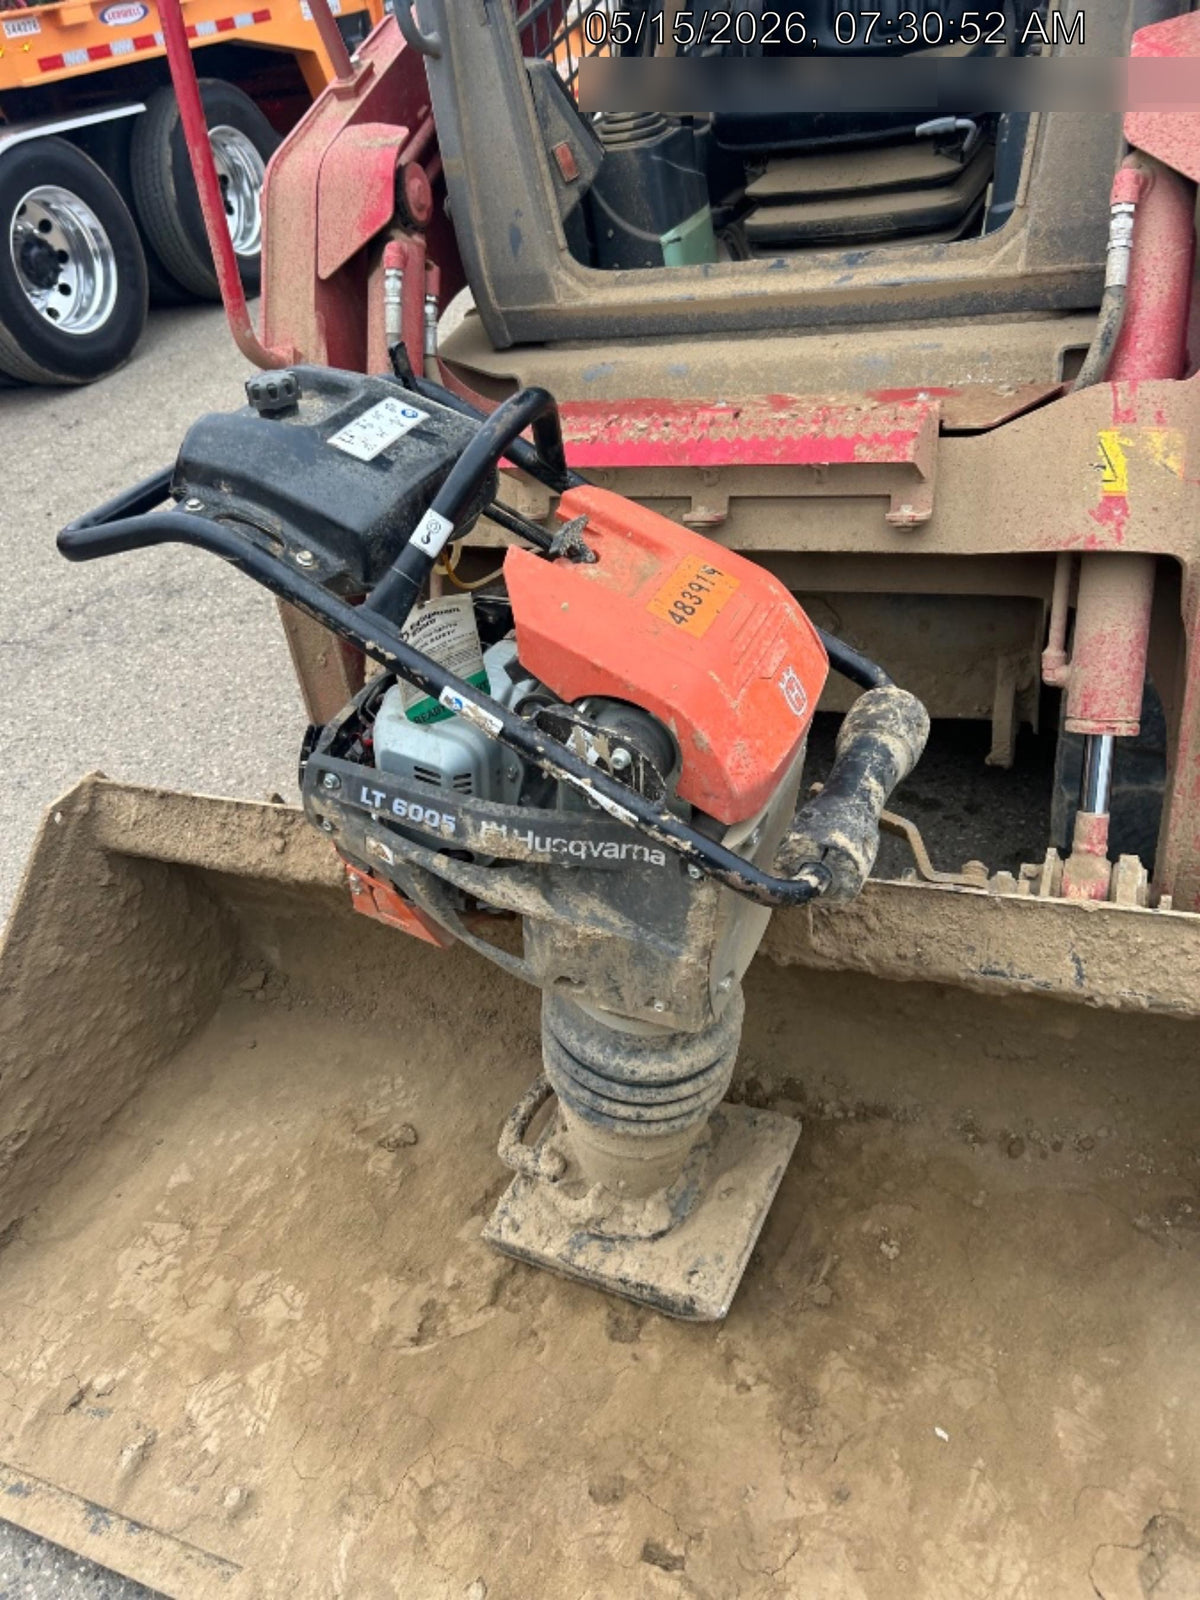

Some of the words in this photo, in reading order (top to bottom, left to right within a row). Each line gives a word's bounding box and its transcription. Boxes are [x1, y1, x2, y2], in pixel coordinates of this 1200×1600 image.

[359, 786, 387, 809] LT
[391, 792, 456, 833] 6005
[513, 828, 667, 867] Husqvarna
